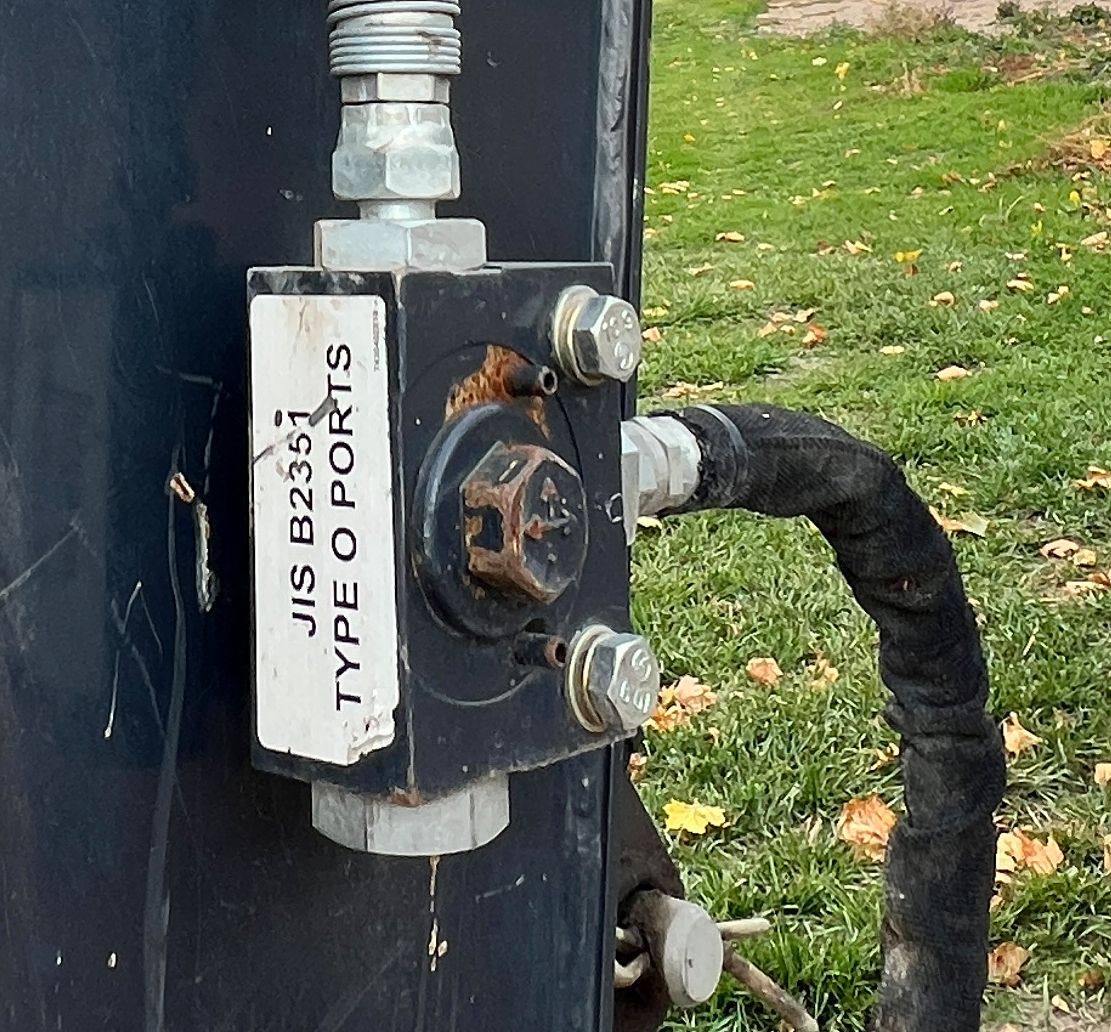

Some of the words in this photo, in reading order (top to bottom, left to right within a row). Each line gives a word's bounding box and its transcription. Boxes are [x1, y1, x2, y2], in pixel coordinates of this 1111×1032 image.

[287, 410, 315, 546] B2351
[326, 343, 356, 509] PORTS
[289, 564, 317, 638] JIS
[331, 526, 358, 562] O
[332, 579, 362, 712] TYPE
